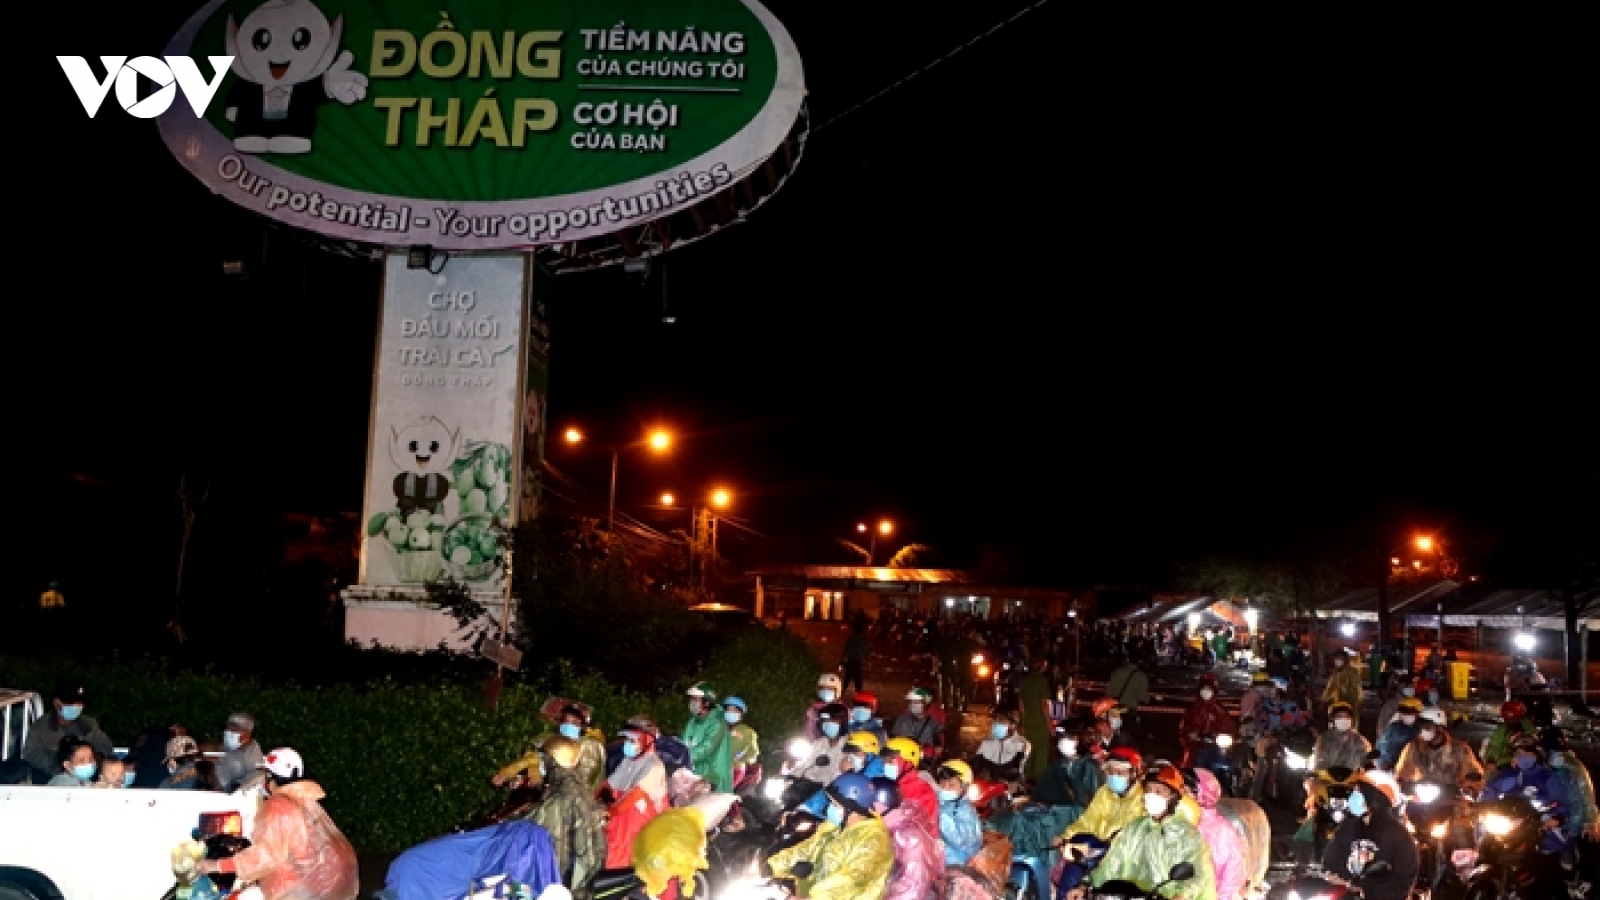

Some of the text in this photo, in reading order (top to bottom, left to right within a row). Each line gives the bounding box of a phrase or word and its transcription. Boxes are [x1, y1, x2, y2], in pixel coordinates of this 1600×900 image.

[369, 11, 564, 79] ĐỒNG
[655, 25, 745, 53] NĂNG
[576, 54, 745, 79] CỦA CHÚNG TÔI
[374, 87, 559, 147] THÁP
[573, 98, 679, 131] CƠ HỘI
[570, 127, 667, 153] CỦA BẠN
[217, 154, 272, 196] Our
[266, 186, 412, 233] potential
[434, 208, 506, 238] Your
[508, 162, 733, 241] opportunities
